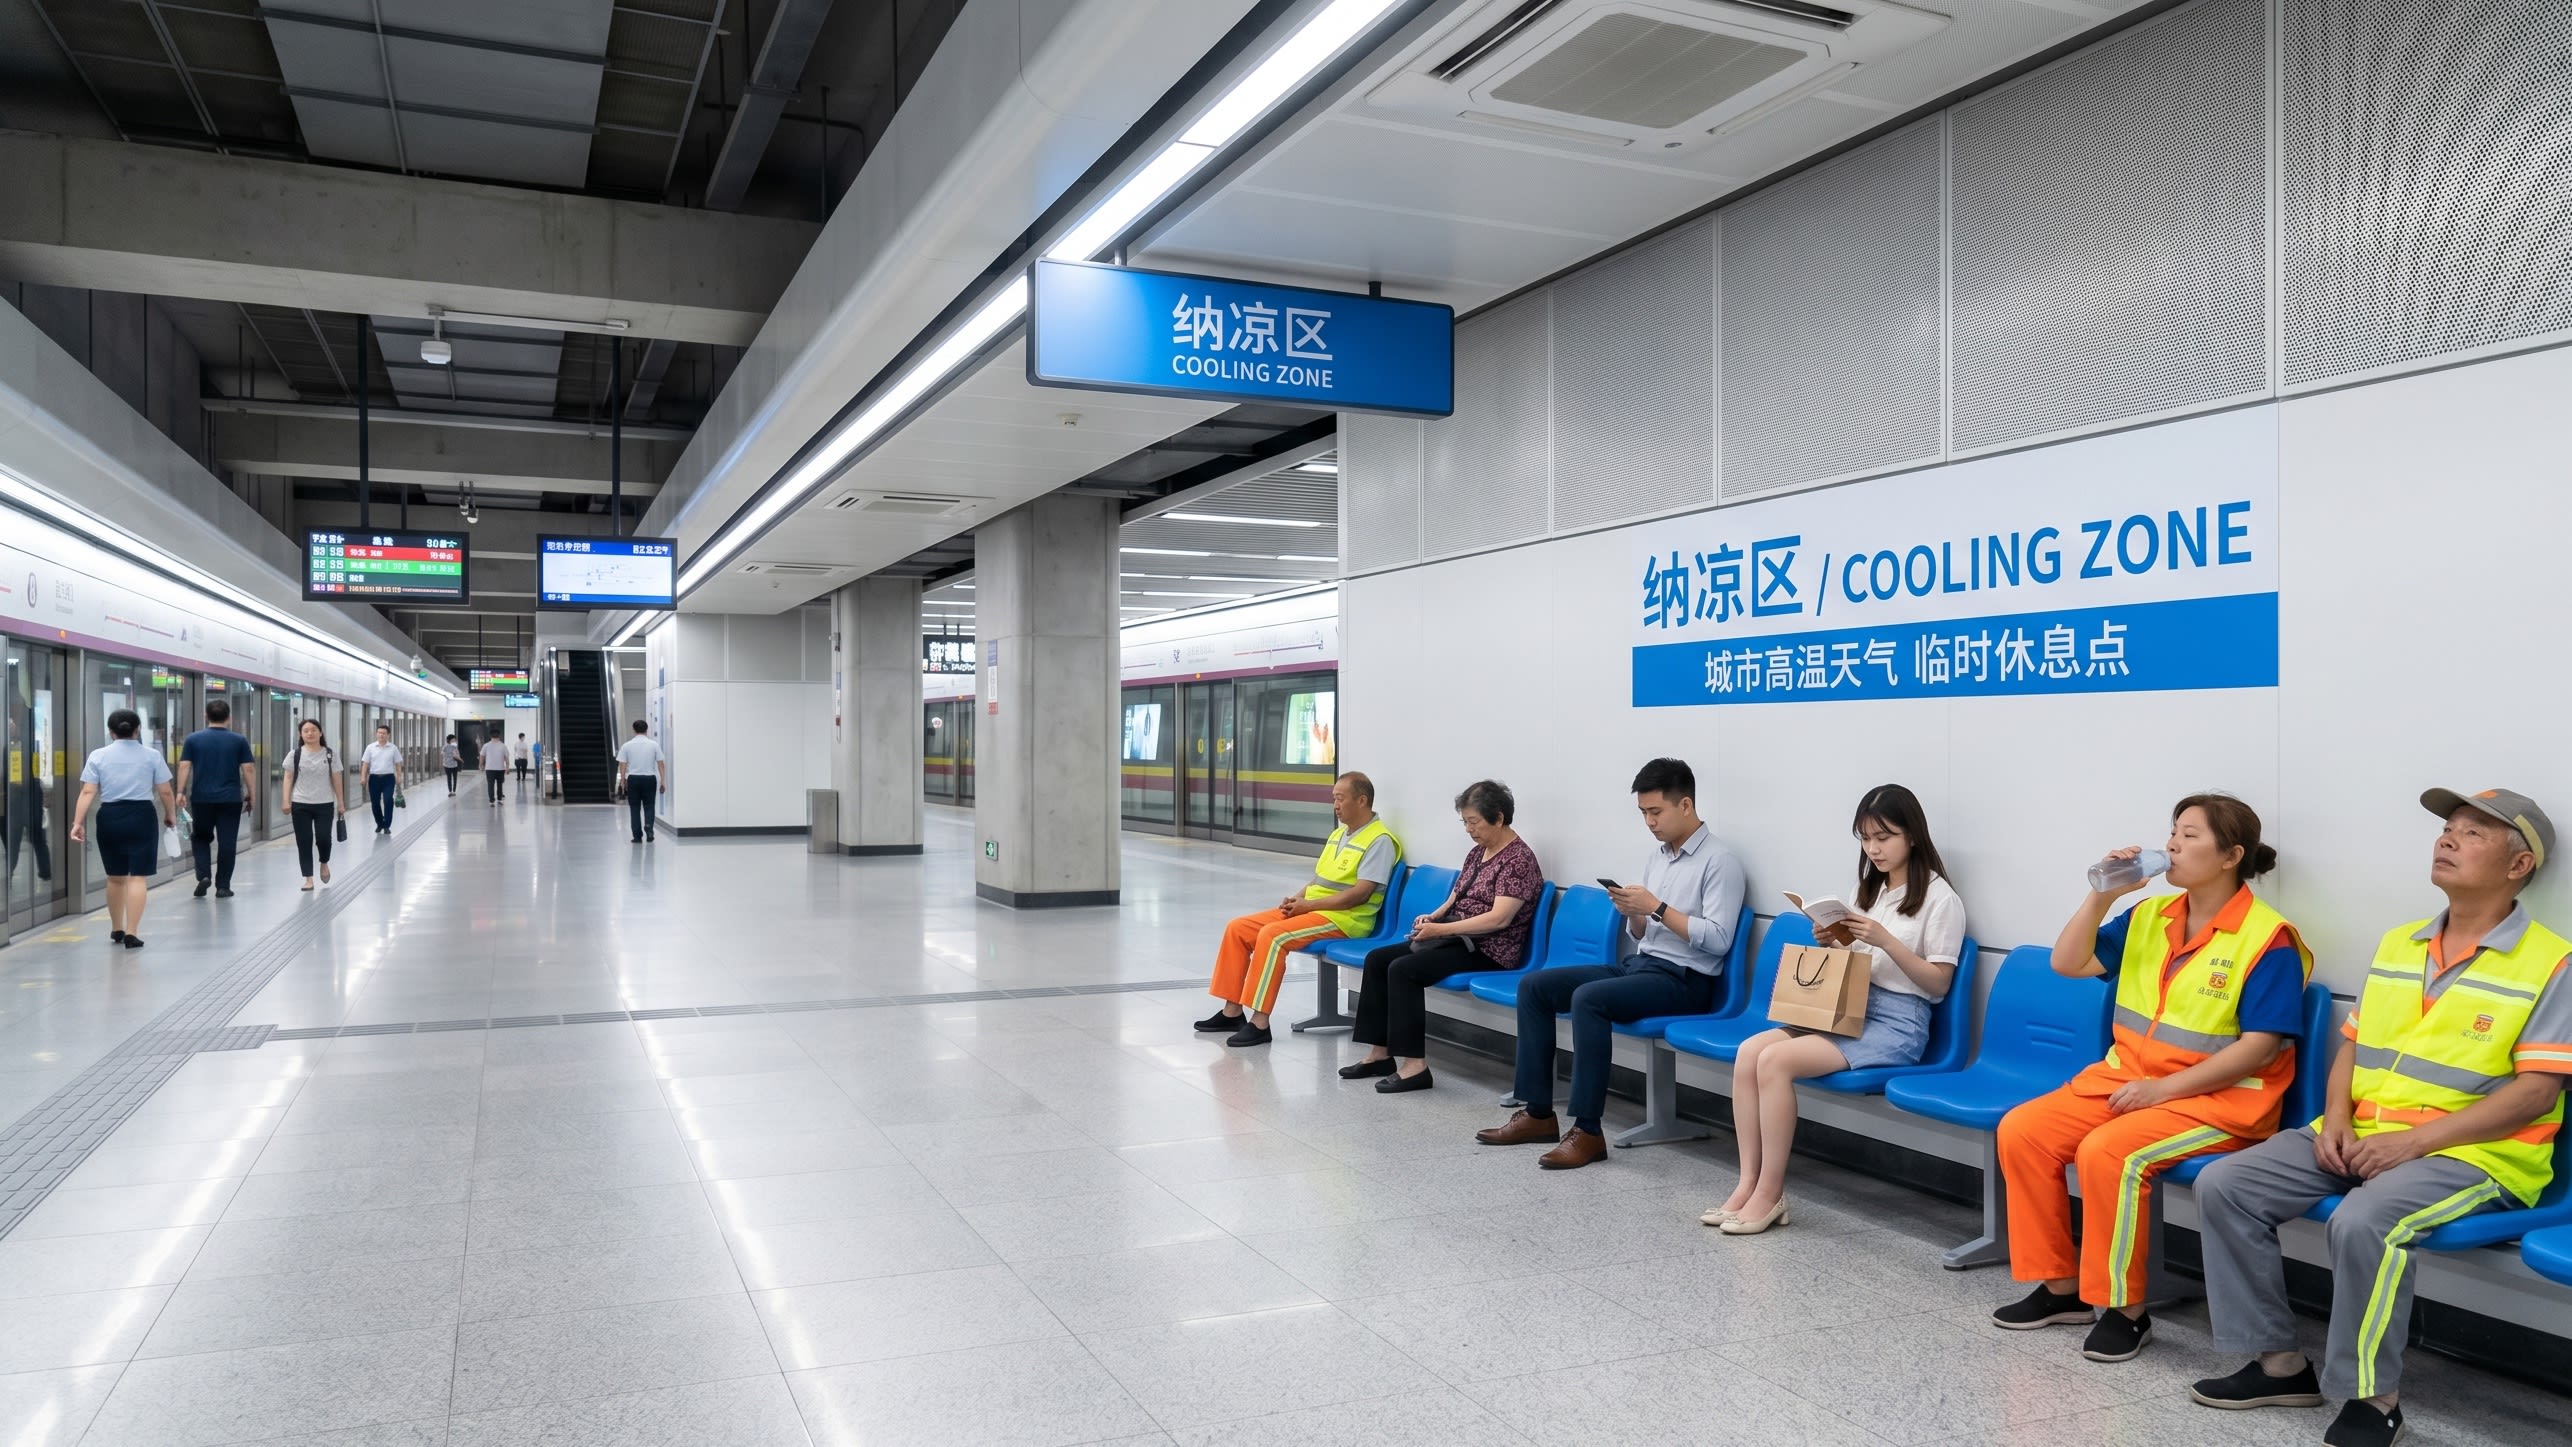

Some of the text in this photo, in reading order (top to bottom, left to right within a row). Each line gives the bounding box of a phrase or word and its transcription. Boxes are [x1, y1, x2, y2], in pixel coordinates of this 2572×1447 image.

[1172, 293, 1333, 361] 纳凉区
[1172, 354, 1333, 389] COOLING ZONE
[1642, 535, 1803, 629] 纳凉区
[1842, 526, 2062, 604] COOLING
[2079, 500, 2253, 580] ZONE
[1704, 619, 2131, 695] 城市高温天气 临时休息点
